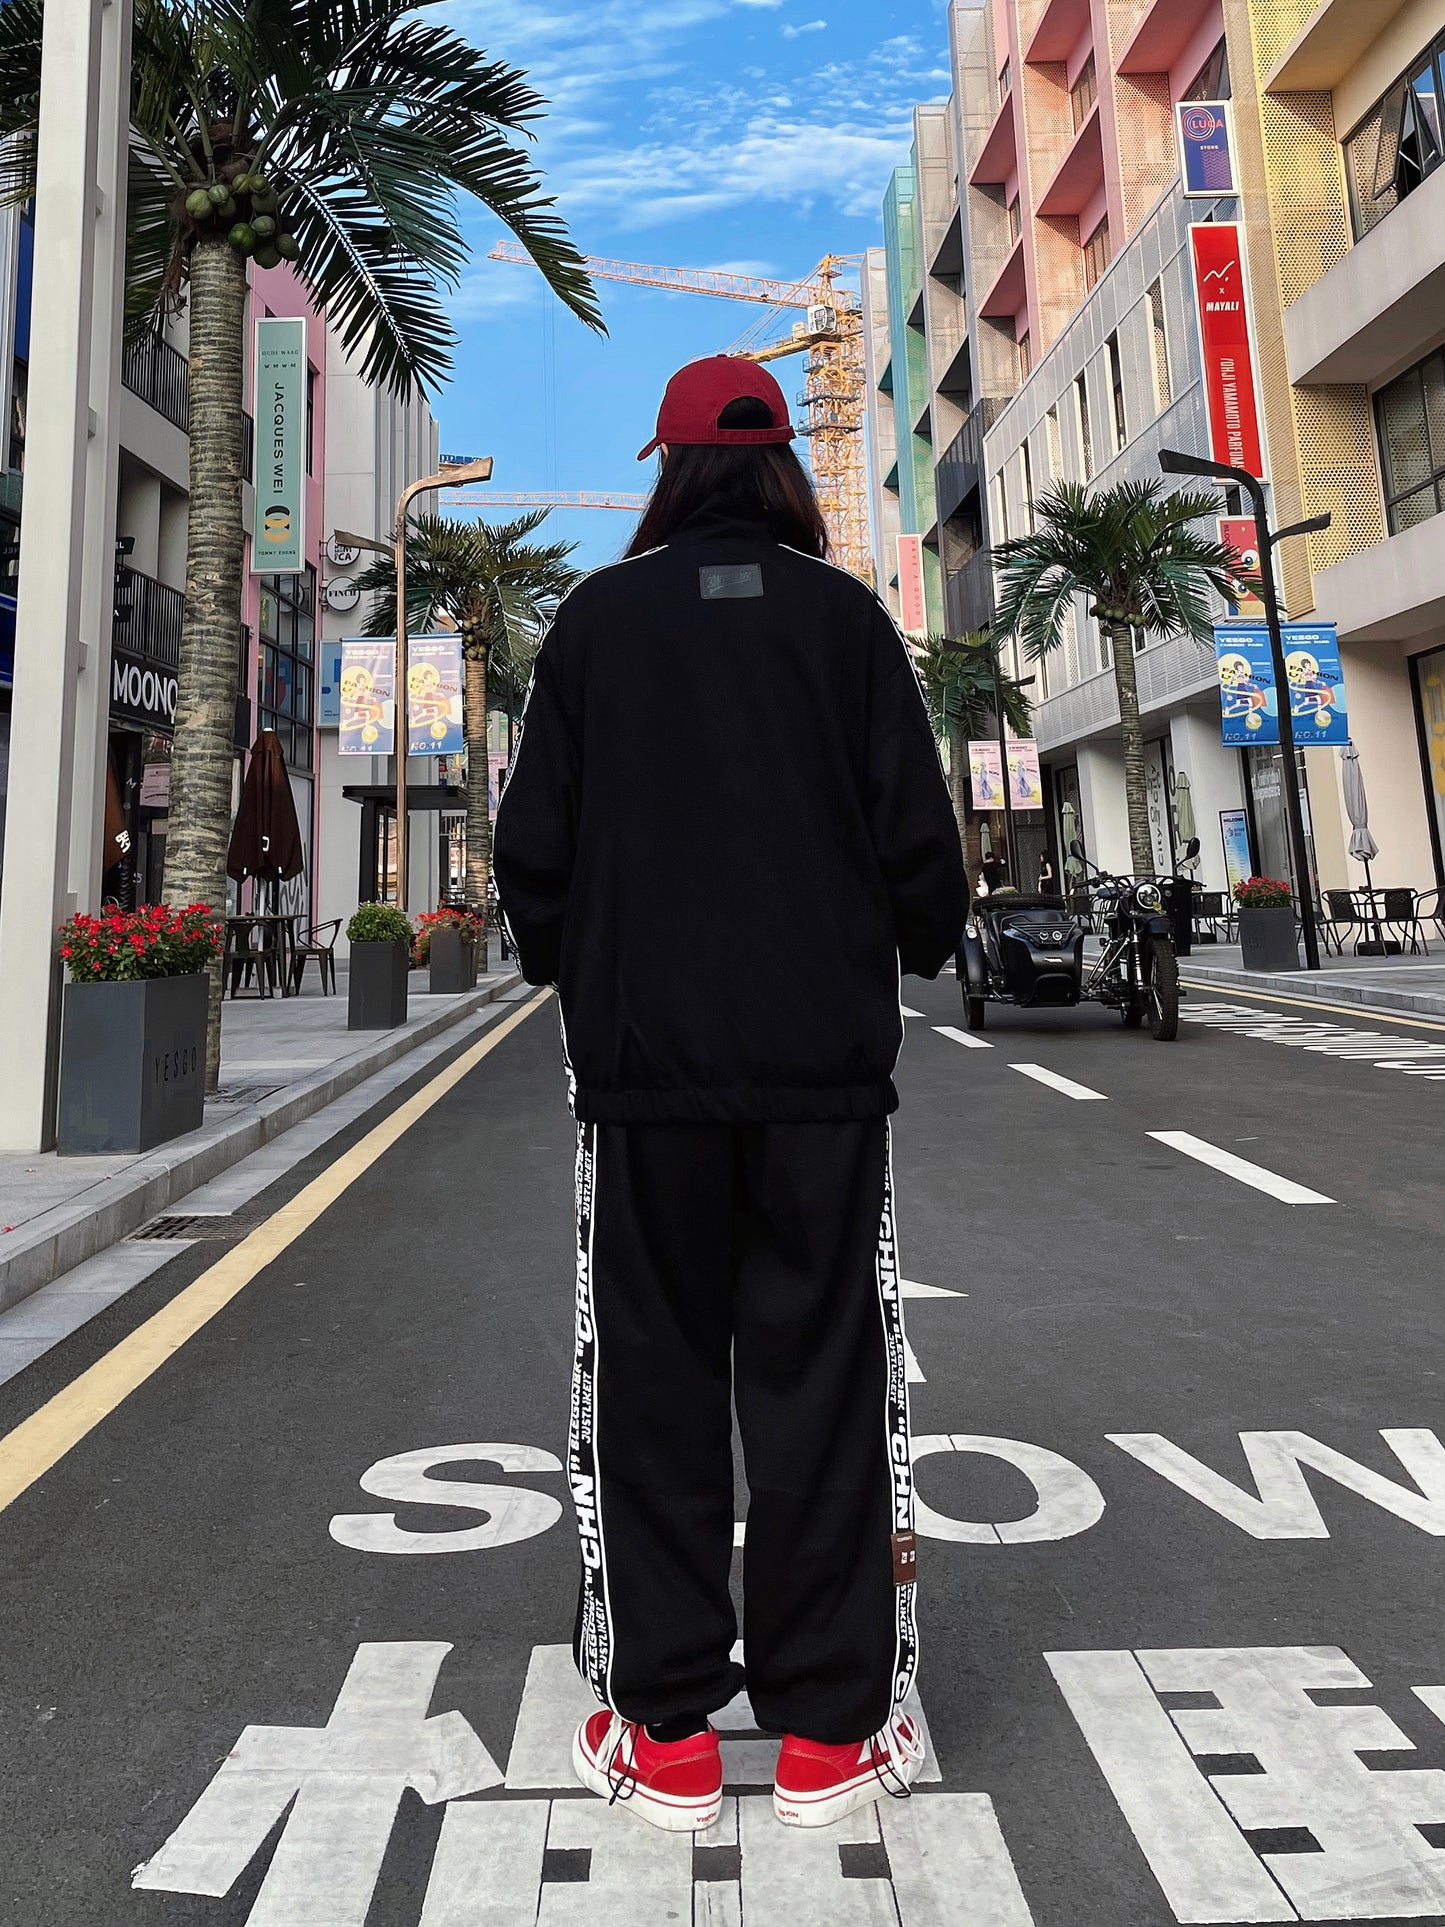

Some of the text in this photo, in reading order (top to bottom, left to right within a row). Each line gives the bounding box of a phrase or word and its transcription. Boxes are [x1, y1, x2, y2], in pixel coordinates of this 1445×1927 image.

[1206, 301, 1240, 312] MAYALI
[1222, 382, 1242, 430] YAMAMOTO
[273, 382, 285, 494] JACQUES WEI
[154, 1046, 197, 1084] YESGO
